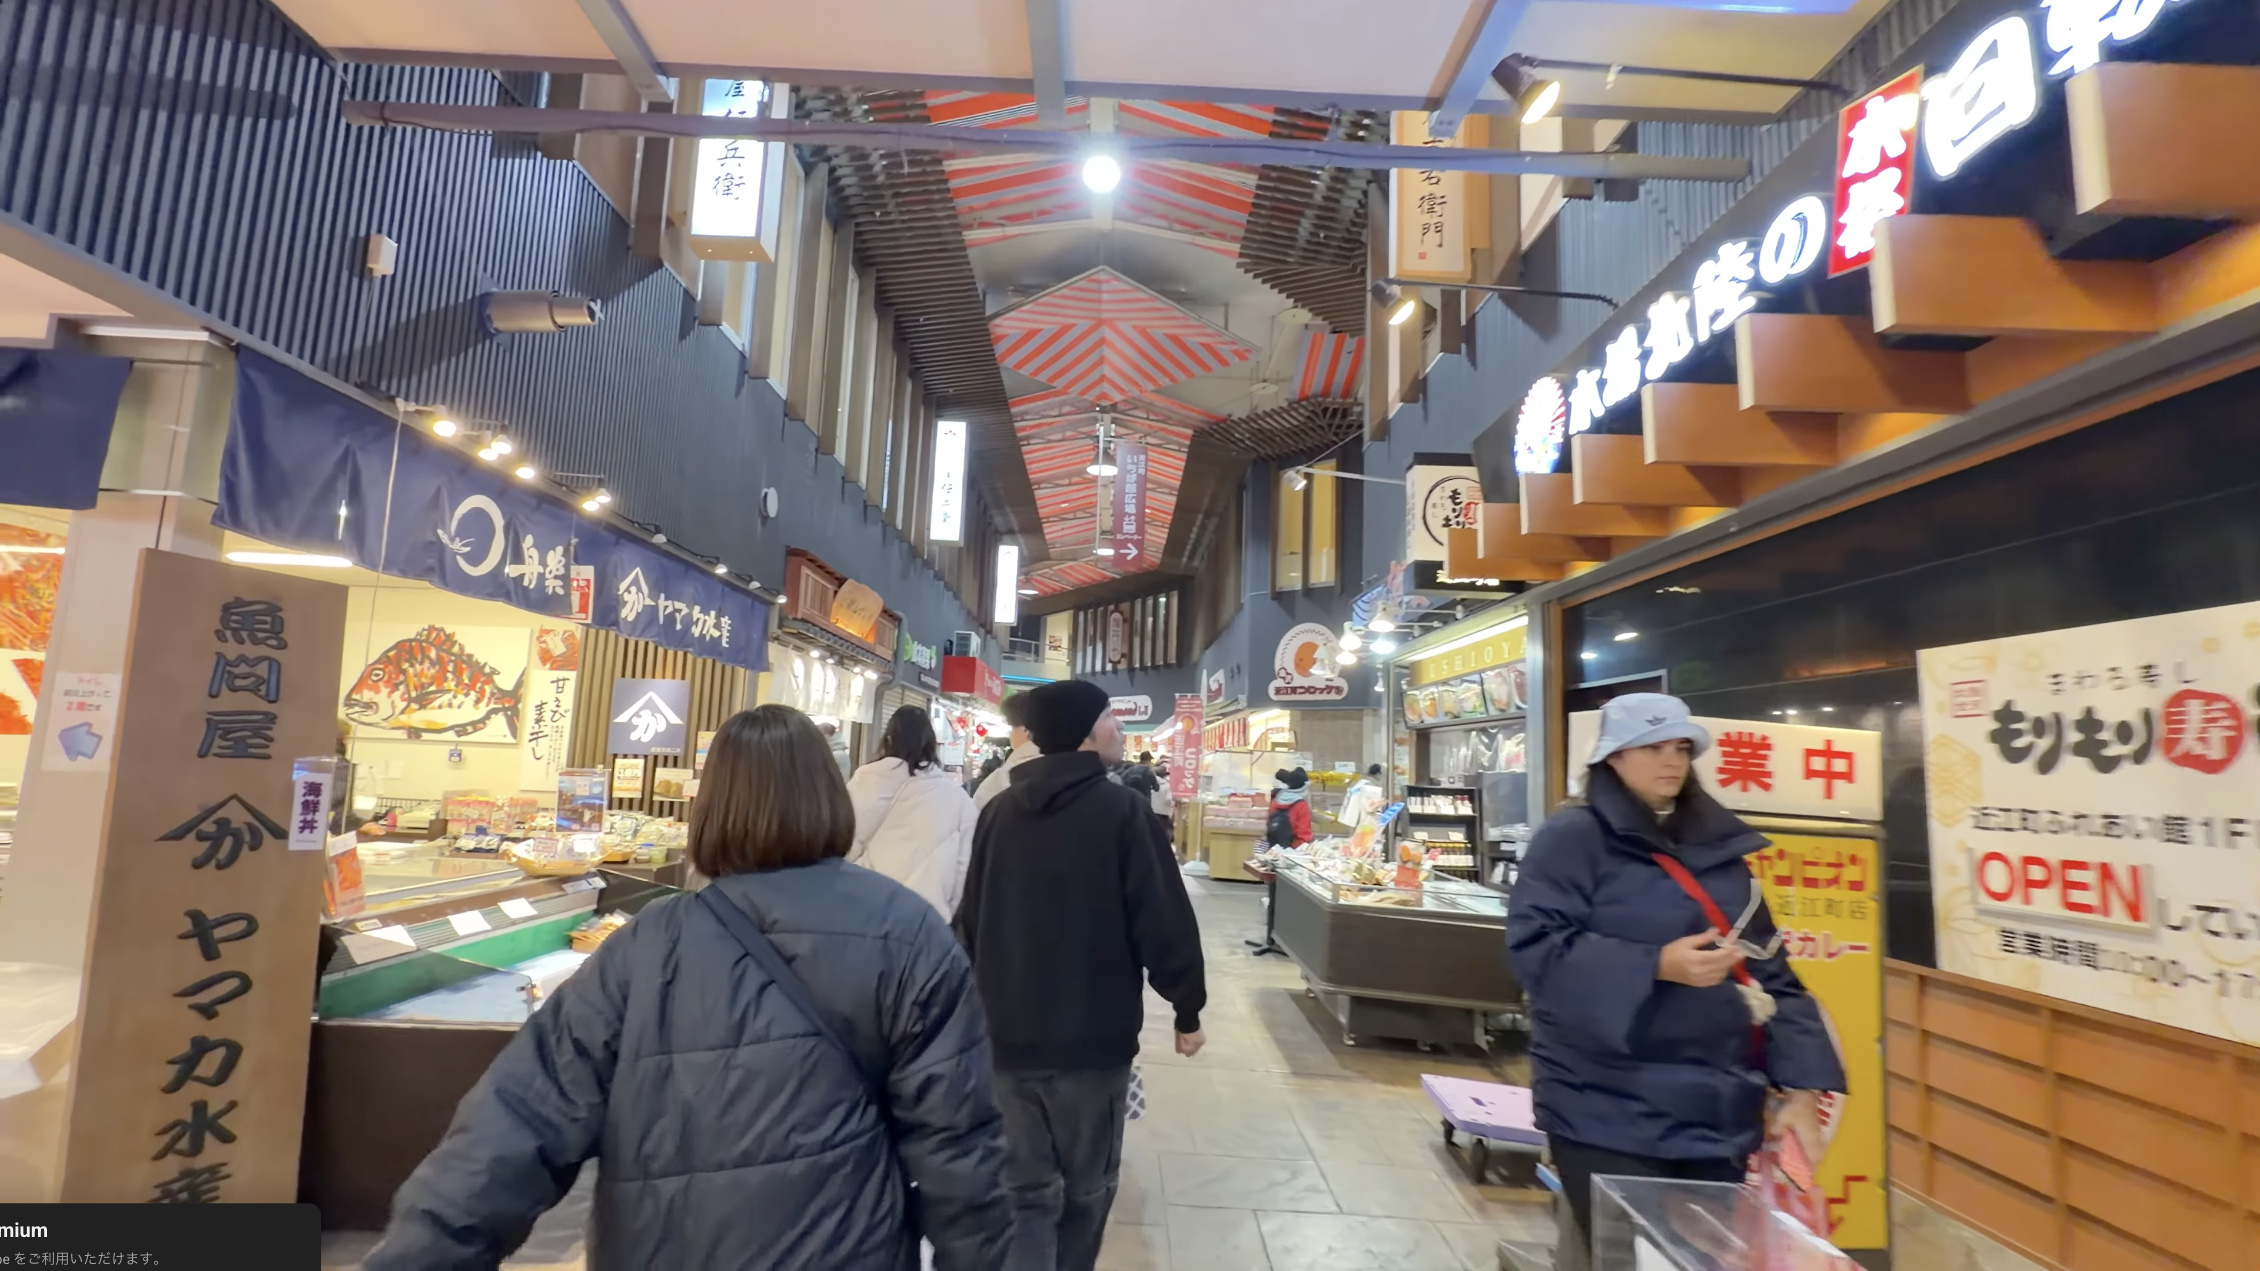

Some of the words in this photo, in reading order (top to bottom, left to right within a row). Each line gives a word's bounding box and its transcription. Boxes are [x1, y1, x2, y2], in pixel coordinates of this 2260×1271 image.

[196, 596, 289, 760] 魚問屋
[550, 677, 571, 723] 甘えび
[1988, 694, 2260, 776] もりもり寿
[298, 781, 322, 835] 海鮮丼
[1745, 848, 1867, 892] ャンピオン
[1976, 851, 2147, 923] OPEN
